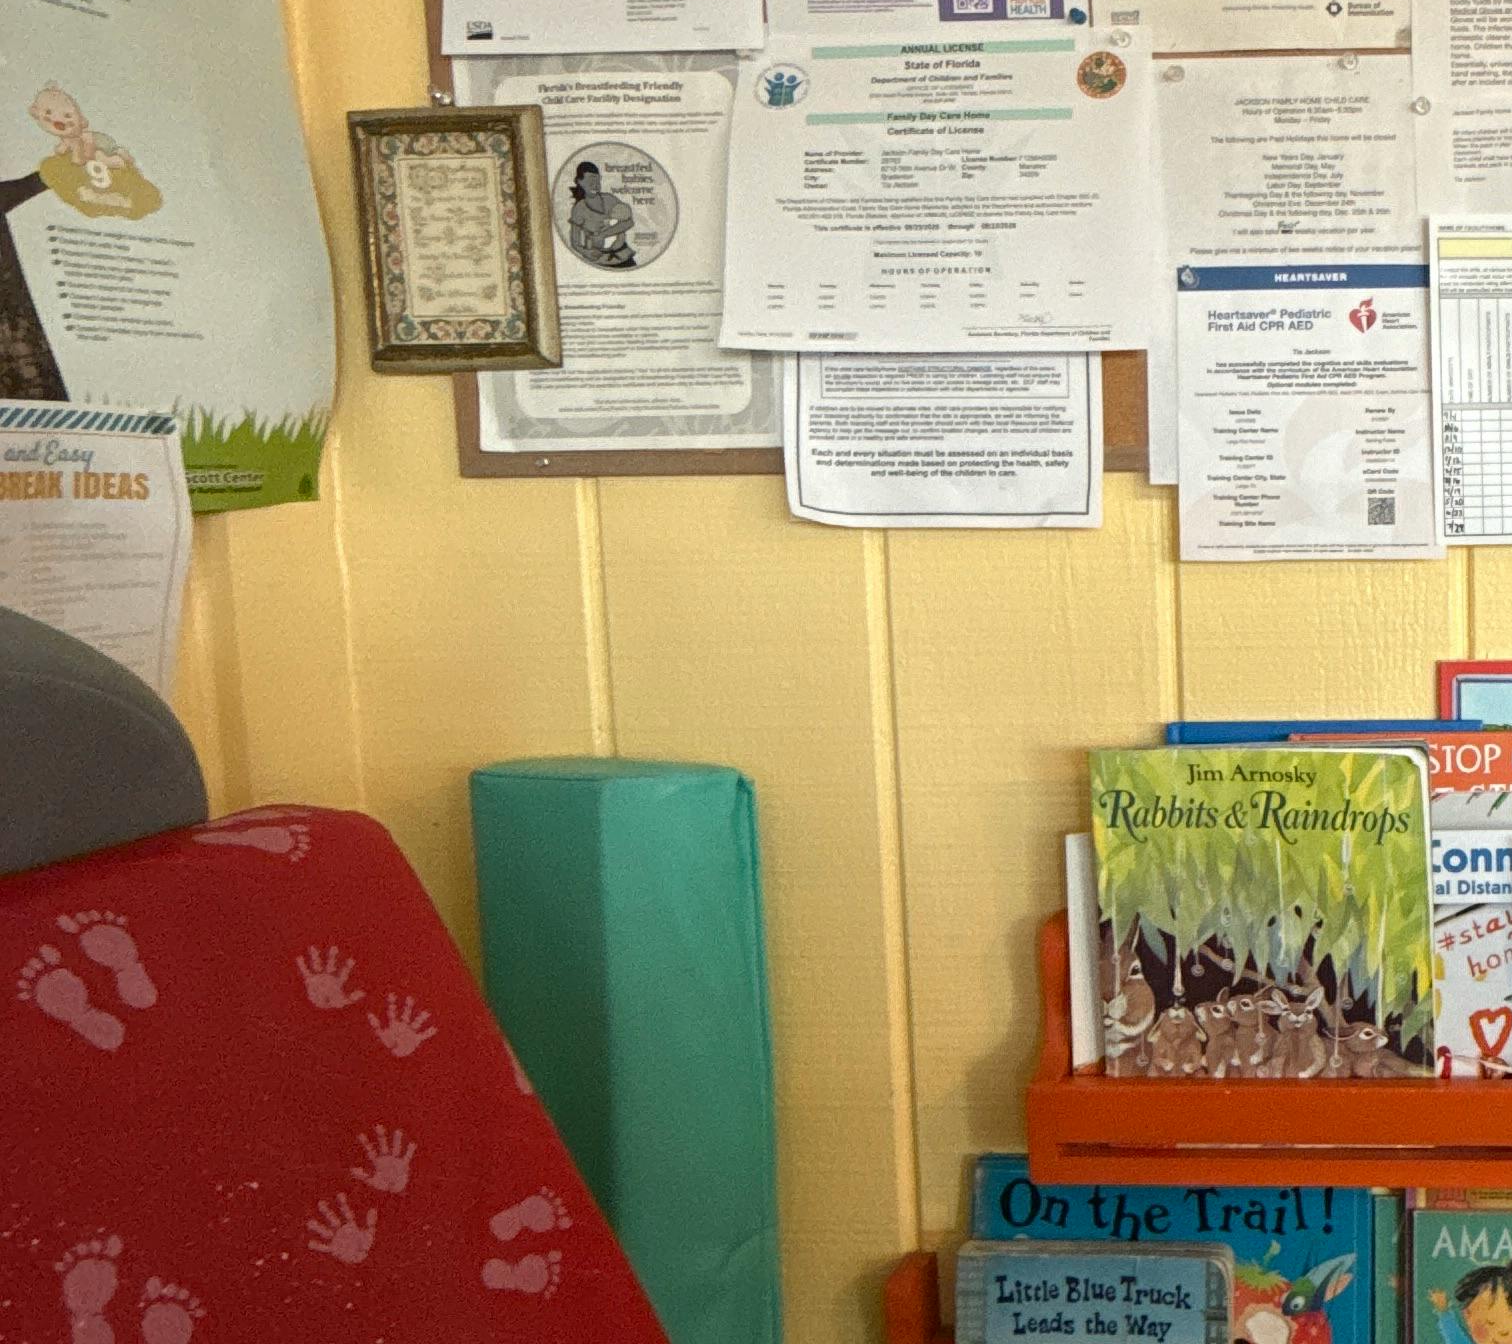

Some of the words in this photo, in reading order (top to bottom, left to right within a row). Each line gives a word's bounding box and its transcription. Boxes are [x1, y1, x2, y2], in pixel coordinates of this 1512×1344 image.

[901, 43, 940, 54] ANNUAL
[943, 43, 984, 53] LICENSE
[904, 60, 930, 70] State
[933, 59, 942, 69] of
[945, 58, 980, 69] Florida
[887, 112, 916, 122] Family
[919, 112, 938, 122] Day
[1274, 273, 1347, 282] HEARTSAVER
[1280, 309, 1331, 319] Pediatric
[1208, 322, 1234, 331] First
[1236, 322, 1256, 331] Aid
[1259, 321, 1285, 331] CPR
[1288, 321, 1313, 331] AED
[1187, 763, 1224, 785] Jim
[1228, 765, 1317, 787] Arnosky
[1100, 789, 1219, 843] Rabbits
[1224, 802, 1248, 829] &
[1250, 790, 1410, 846] Raindrops
[1000, 1178, 1069, 1228] On
[1089, 1184, 1169, 1242] the
[1184, 1188, 1334, 1234] Trail!
[996, 1275, 1060, 1306] Little
[1065, 1277, 1116, 1302] Blue
[1120, 1277, 1191, 1309] Truck
[1013, 1312, 1075, 1336] Leads
[1085, 1313, 1118, 1335] the
[1125, 1314, 1172, 1342] Way
